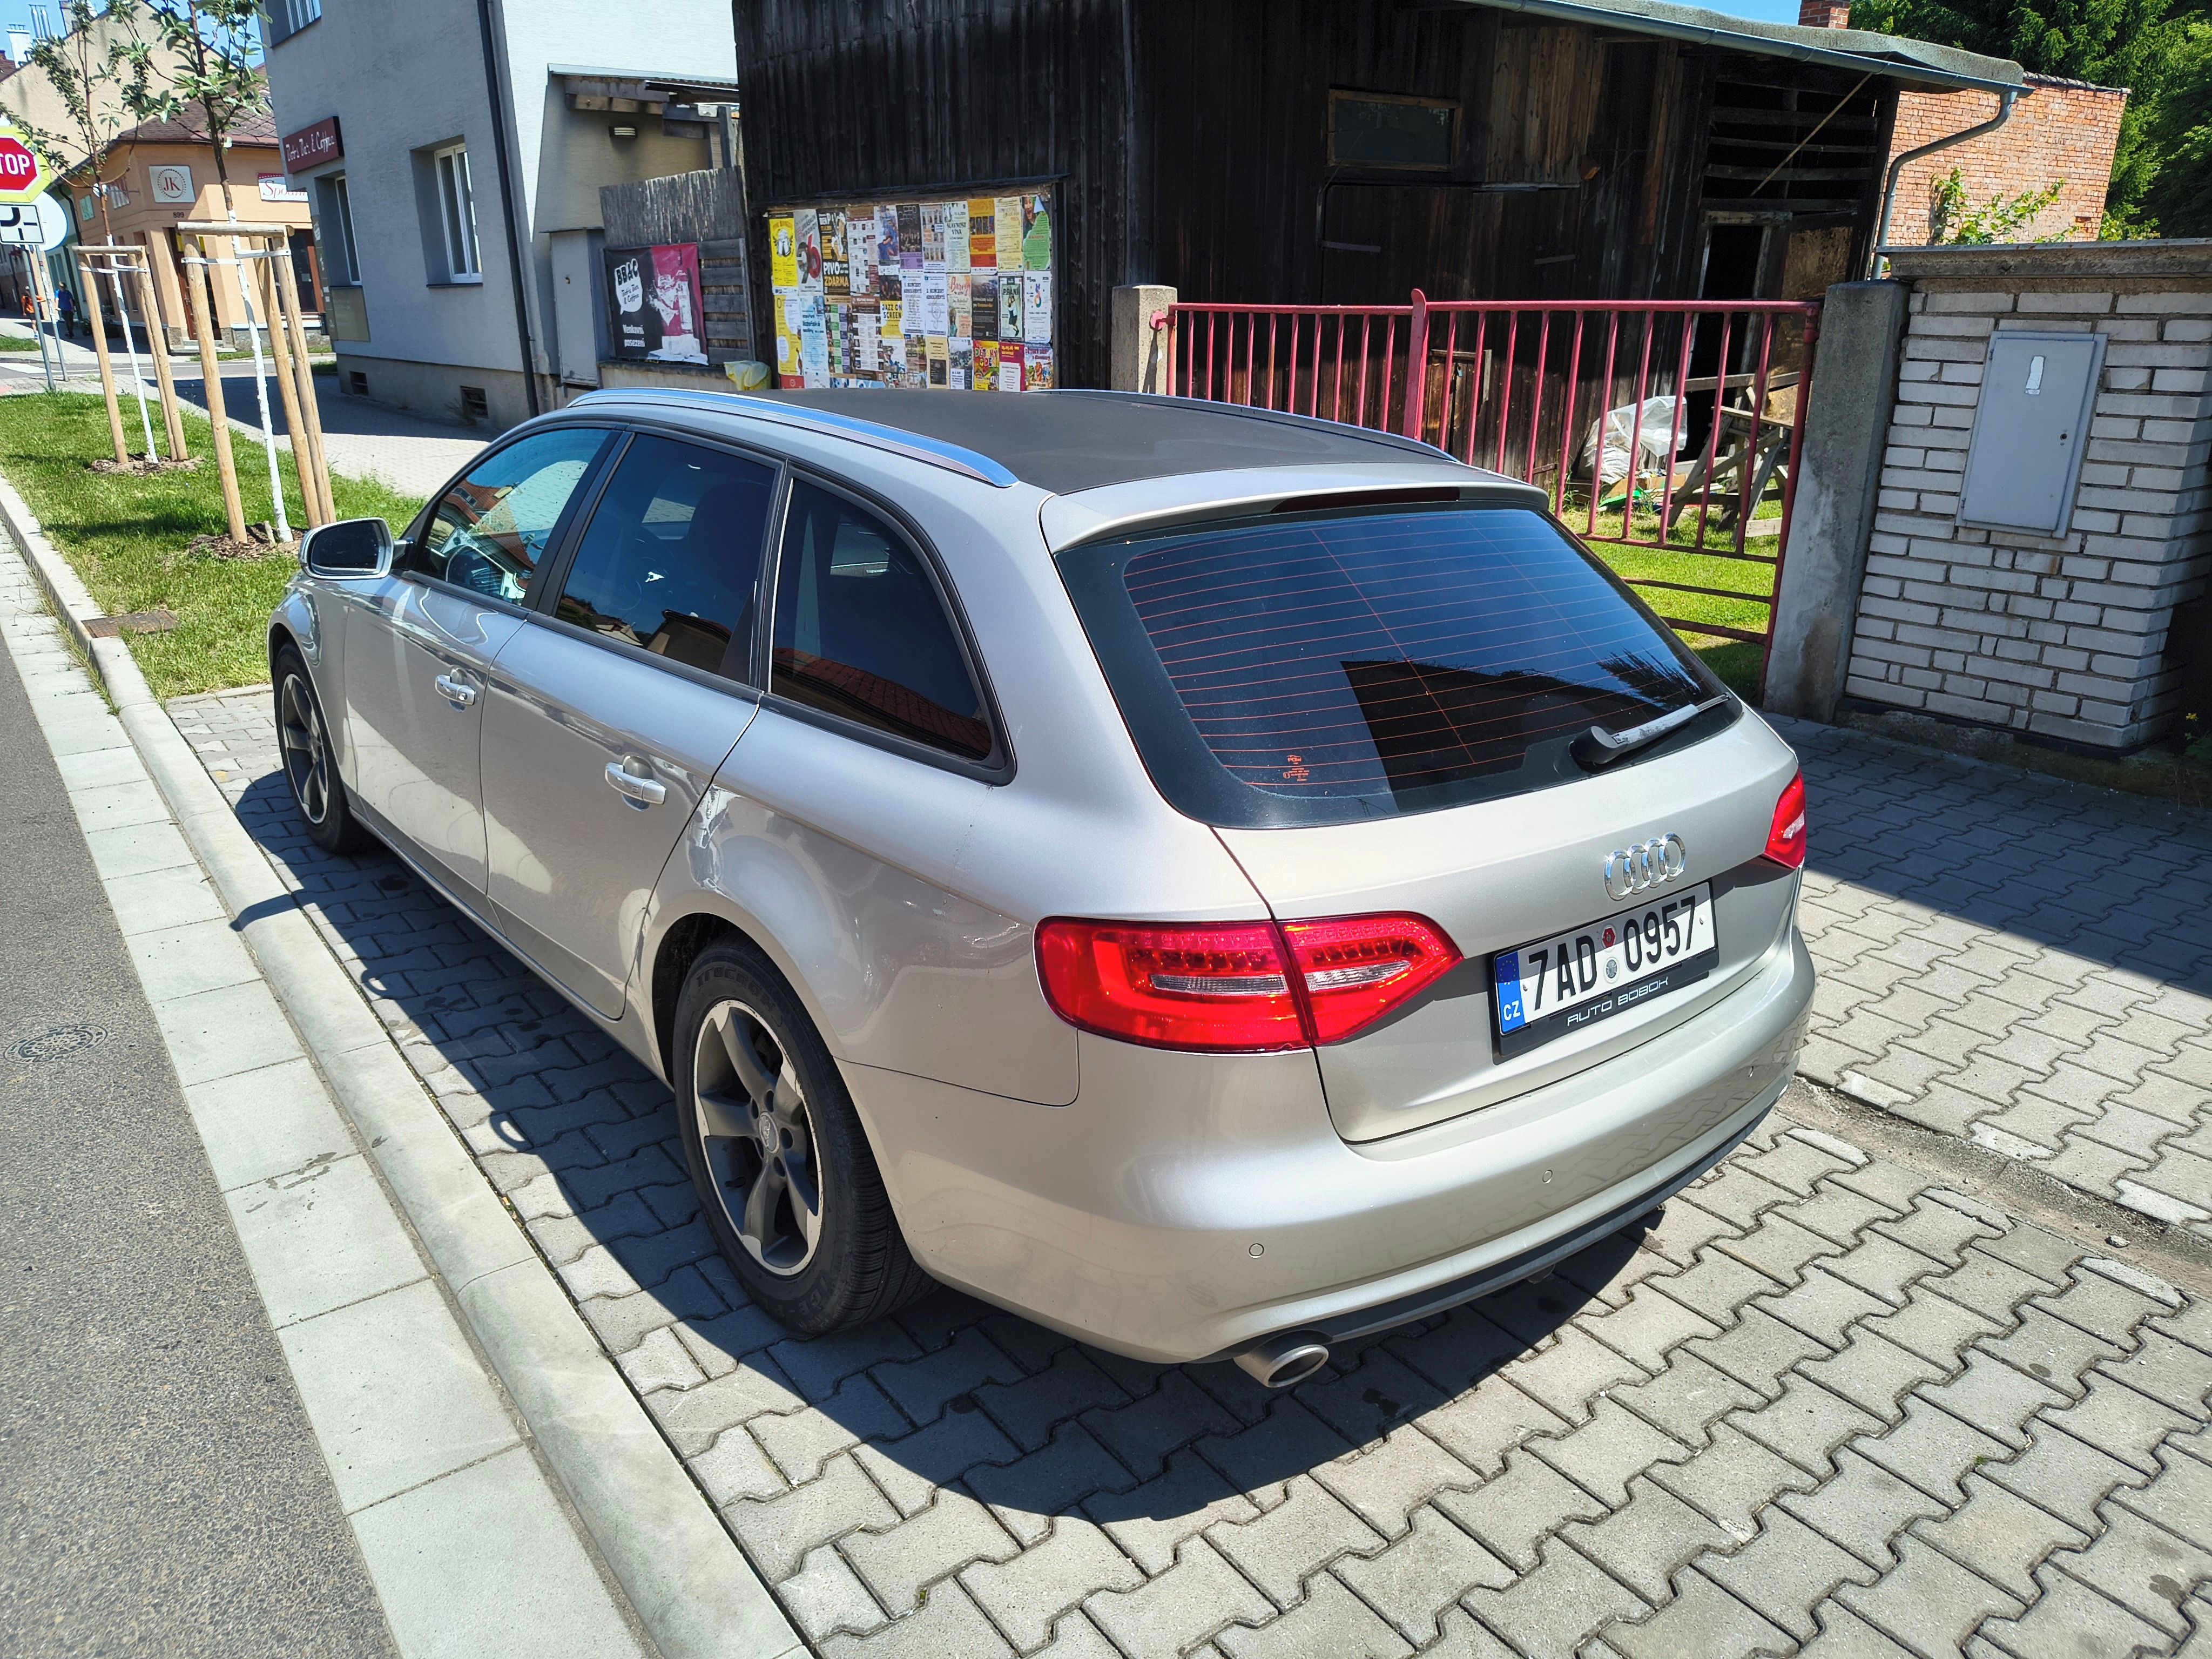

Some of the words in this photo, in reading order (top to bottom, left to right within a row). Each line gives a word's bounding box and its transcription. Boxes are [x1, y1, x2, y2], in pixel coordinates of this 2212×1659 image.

[164, 177, 181, 191] JK
[823, 262, 840, 275] PIVO
[824, 276, 849, 287] ZDARMA
[1528, 935, 1597, 1011] 7AD
[1623, 895, 1696, 972] 0957
[1503, 1000, 1521, 1021] CZ
[1567, 1000, 1613, 1026] AUTO
